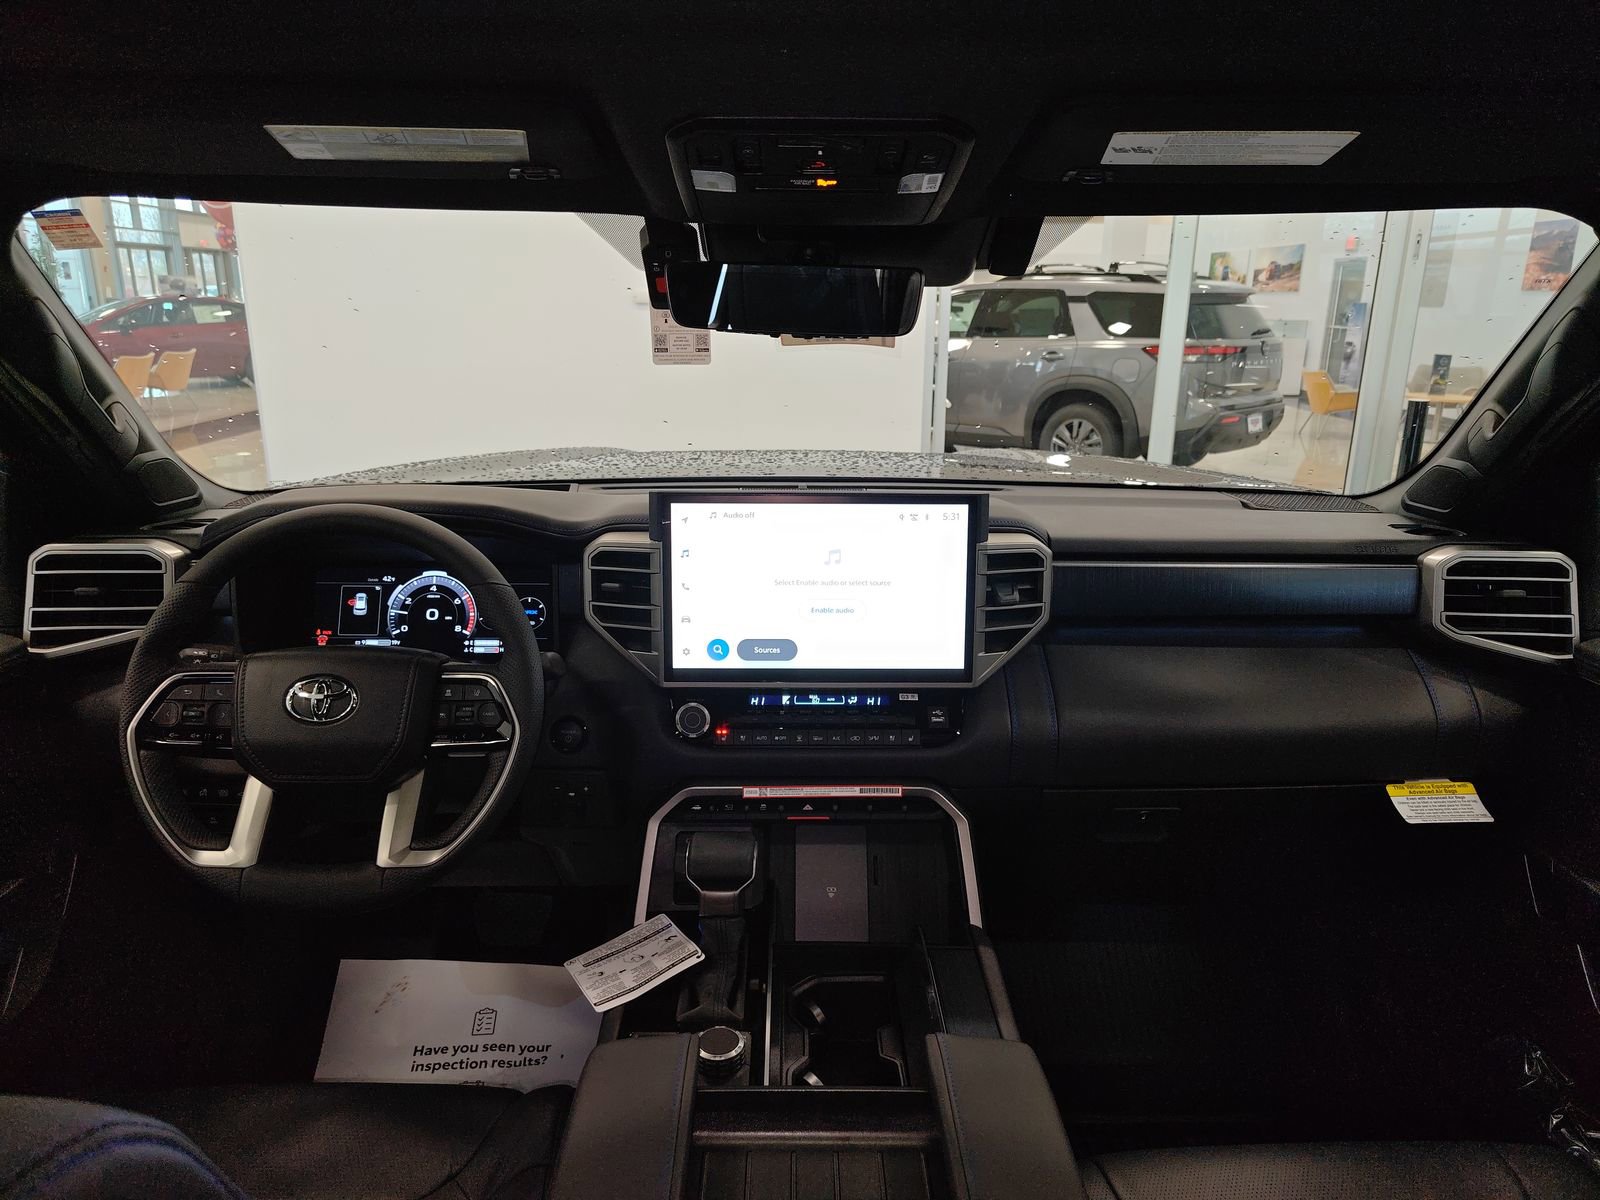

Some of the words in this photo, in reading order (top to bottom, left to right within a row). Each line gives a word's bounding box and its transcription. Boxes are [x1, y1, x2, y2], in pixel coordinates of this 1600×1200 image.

[723, 511, 743, 519] Audio
[744, 511, 755, 519] off
[942, 513, 960, 521] 5:31
[774, 578, 795, 587] Select
[796, 578, 819, 587] Enable
[820, 578, 839, 587] audio
[848, 578, 868, 587] select
[404, 597, 412, 605] 2
[454, 597, 462, 605] 6
[811, 606, 834, 614] Enable
[835, 606, 855, 614] audio
[425, 608, 440, 621] 0
[753, 645, 781, 654] Sources
[1431, 783, 1456, 791] Equipped
[413, 1044, 449, 1057] Have
[451, 1043, 479, 1057] you
[482, 1043, 515, 1053] seen
[518, 1043, 552, 1056] your
[410, 1058, 488, 1074] inspection
[491, 1055, 548, 1069] results?
